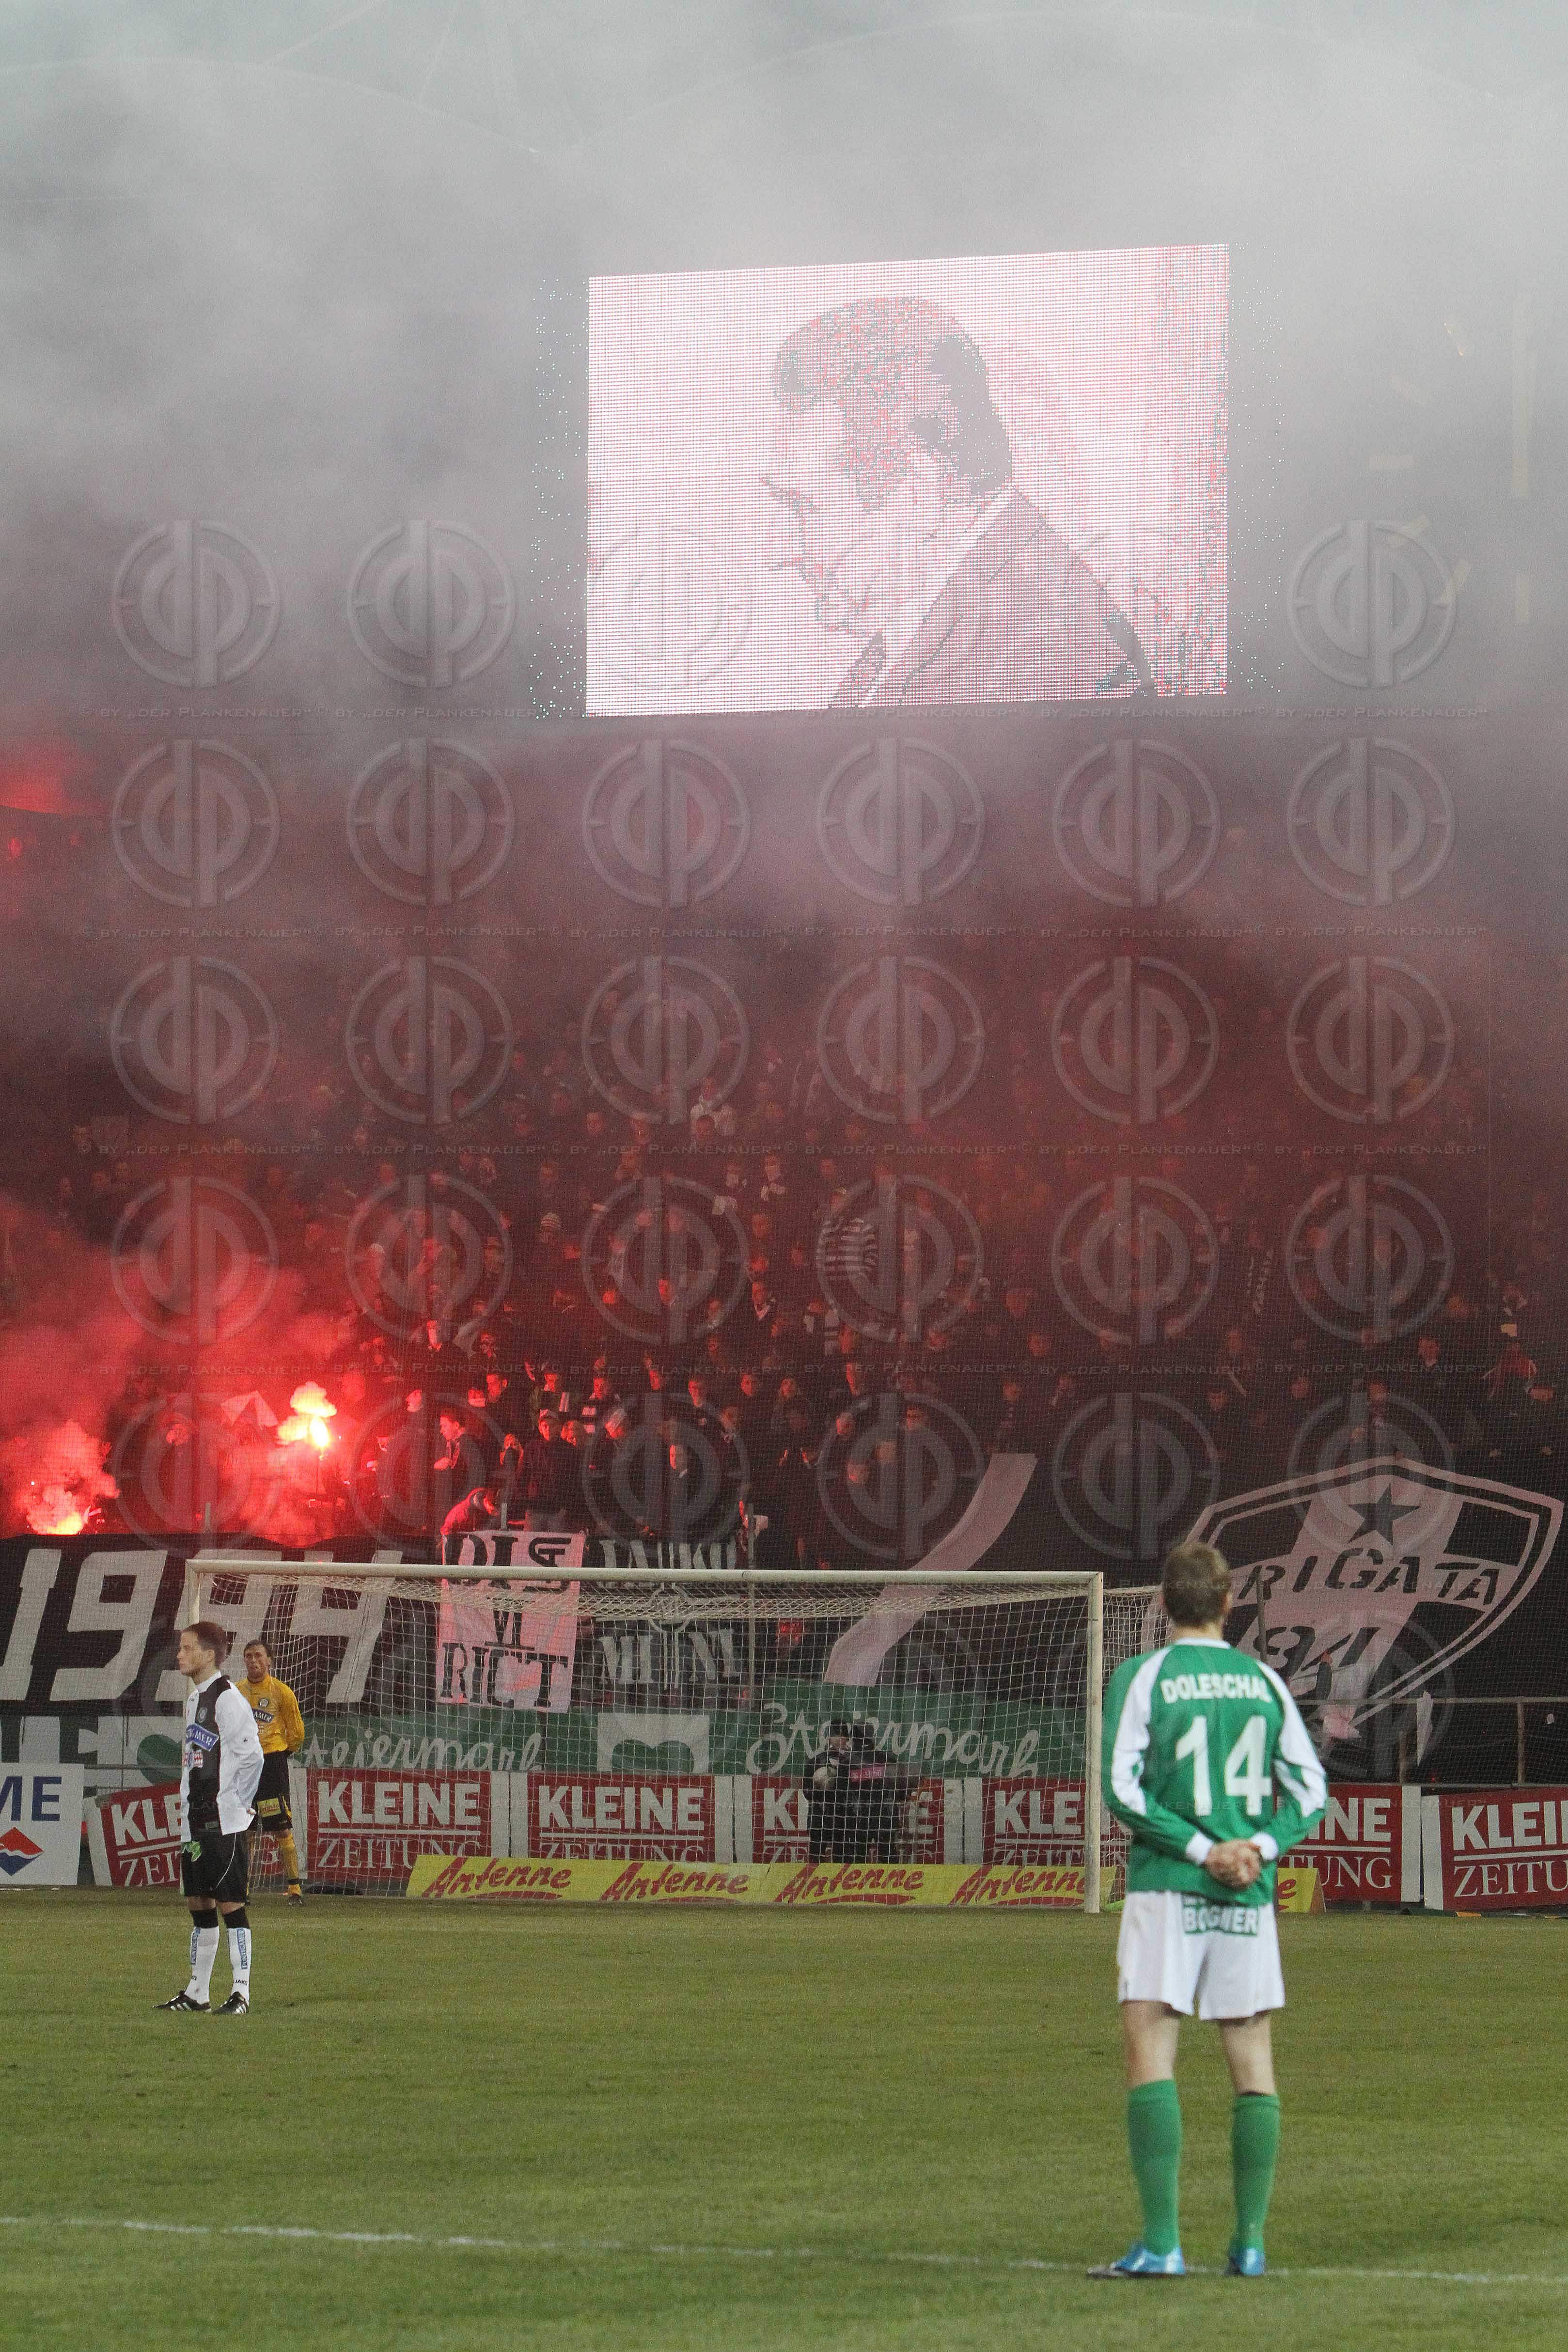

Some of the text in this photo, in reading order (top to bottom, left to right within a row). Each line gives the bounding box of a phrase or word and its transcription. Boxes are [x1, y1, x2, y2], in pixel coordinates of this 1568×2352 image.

[1239, 1548, 1501, 1605] RIGATA
[1160, 1673, 1272, 1704] DOLESCHAL
[1175, 1715, 1272, 1816] 14
[318, 1781, 481, 1826] KLEINE
[539, 1786, 705, 1830] KLEINE
[995, 1790, 1110, 1835] KLE
[1452, 1801, 1568, 1850] KLEI
[422, 1857, 572, 1898] Antenne
[600, 1863, 749, 1900] Antenne
[775, 1863, 924, 1903] Antenne
[1454, 1860, 1568, 1897] ZEITU
